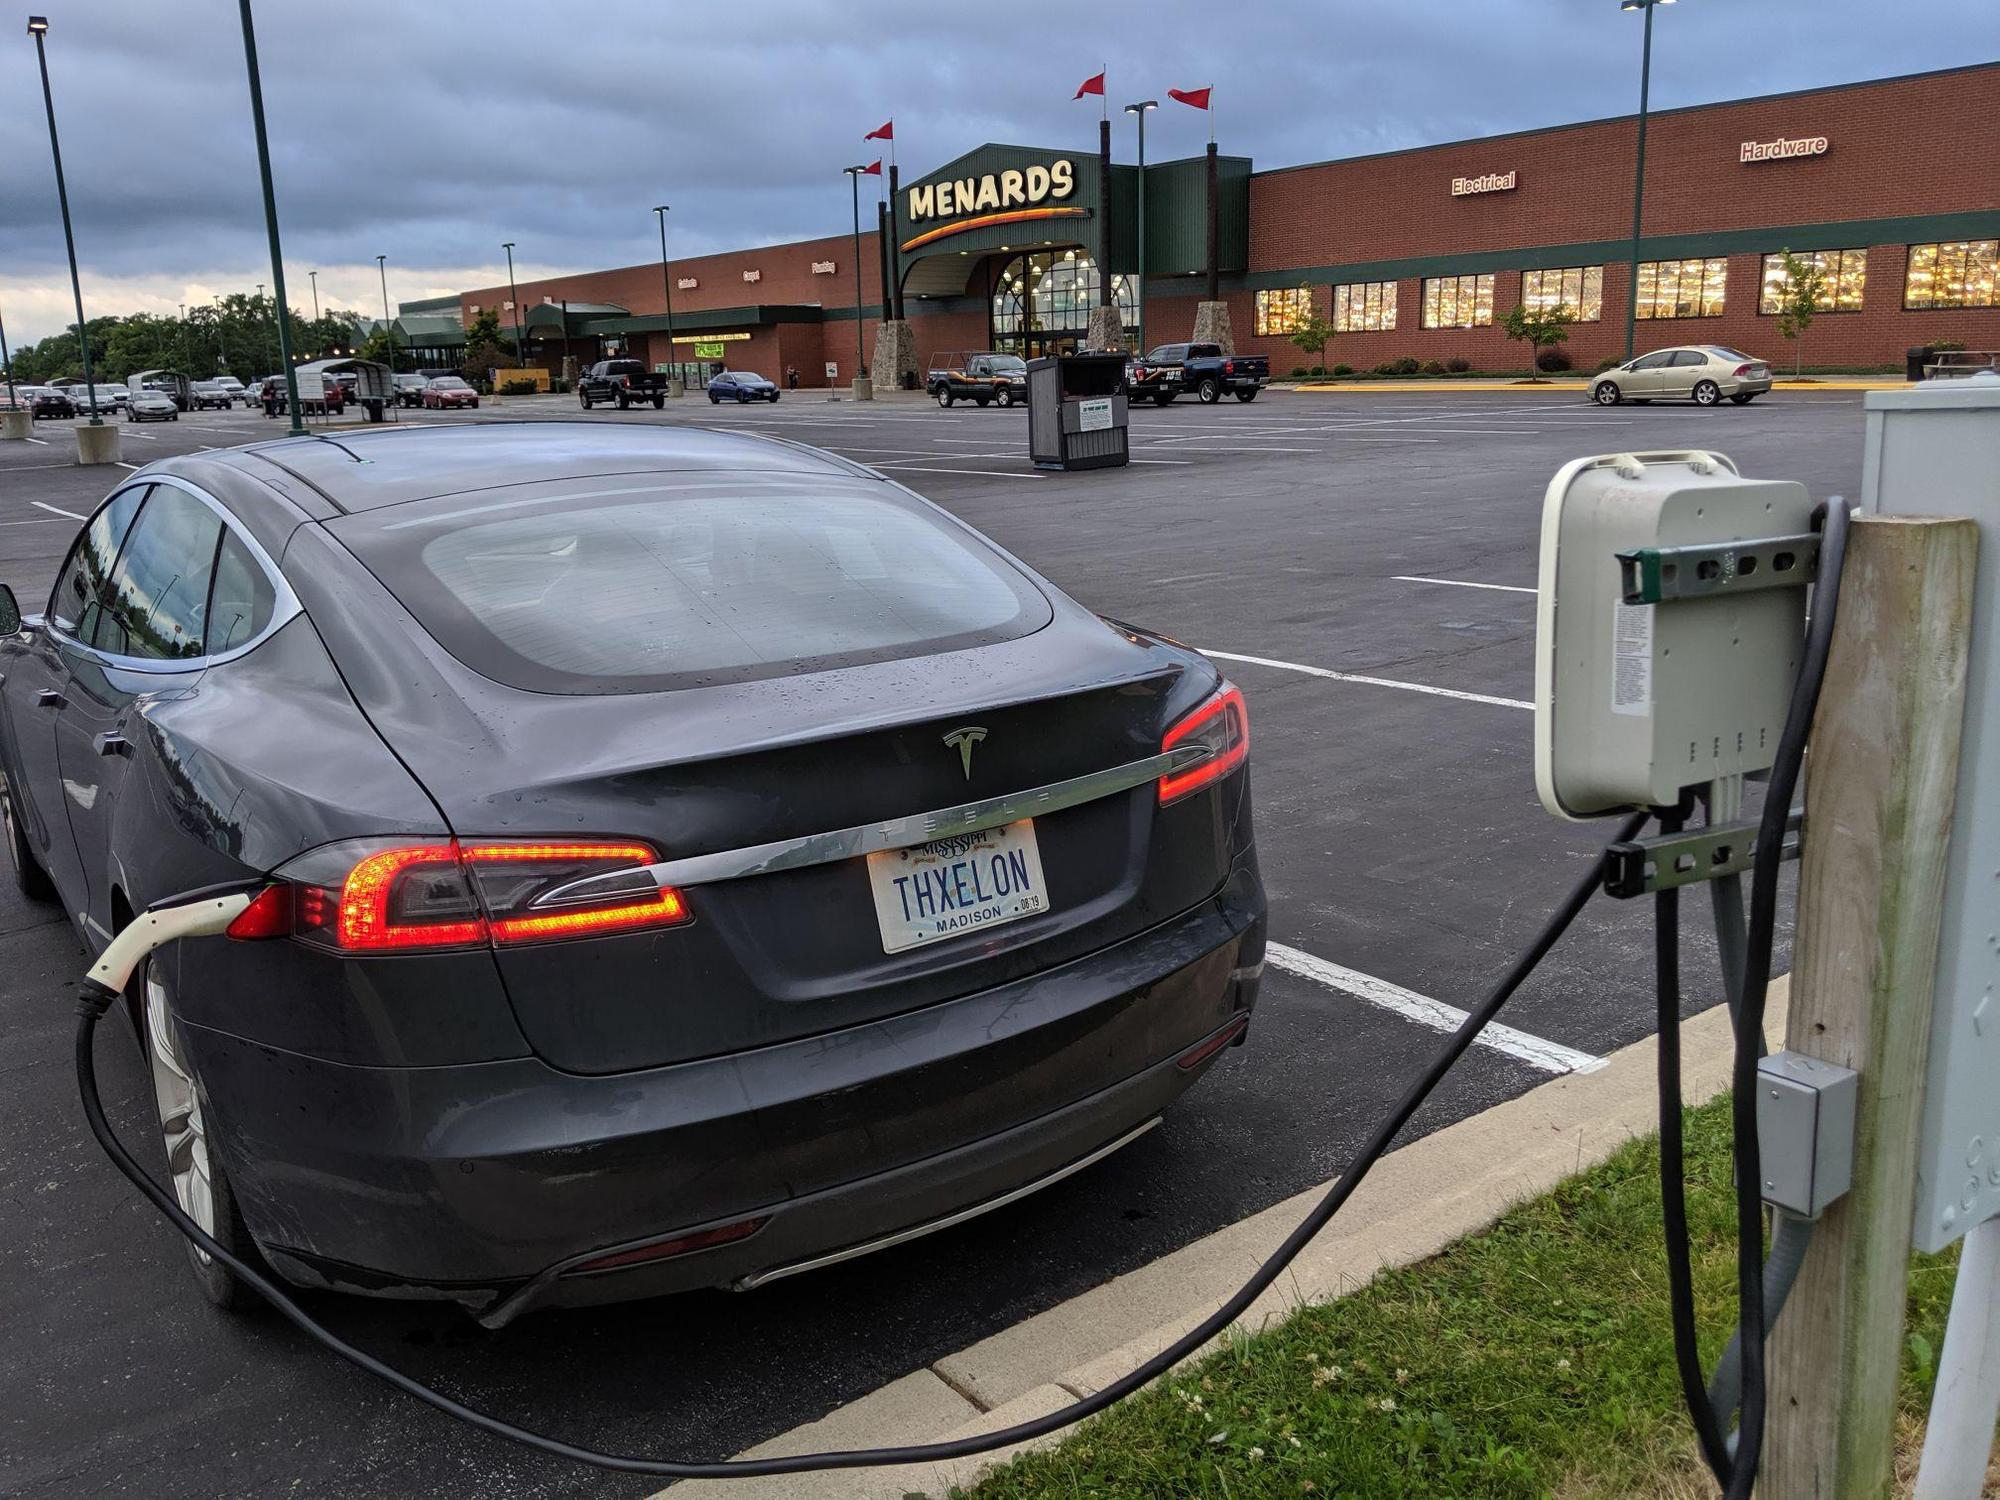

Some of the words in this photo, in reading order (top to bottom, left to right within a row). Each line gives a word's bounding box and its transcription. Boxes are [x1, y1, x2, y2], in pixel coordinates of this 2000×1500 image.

[1740, 137, 1828, 163] Hardware
[909, 160, 1073, 220] MENARDS
[1451, 171, 1516, 196] Electrical
[922, 831, 987, 859] MISSISSIPPI
[893, 848, 1030, 922] THXELON
[936, 905, 1002, 933] MADISON
